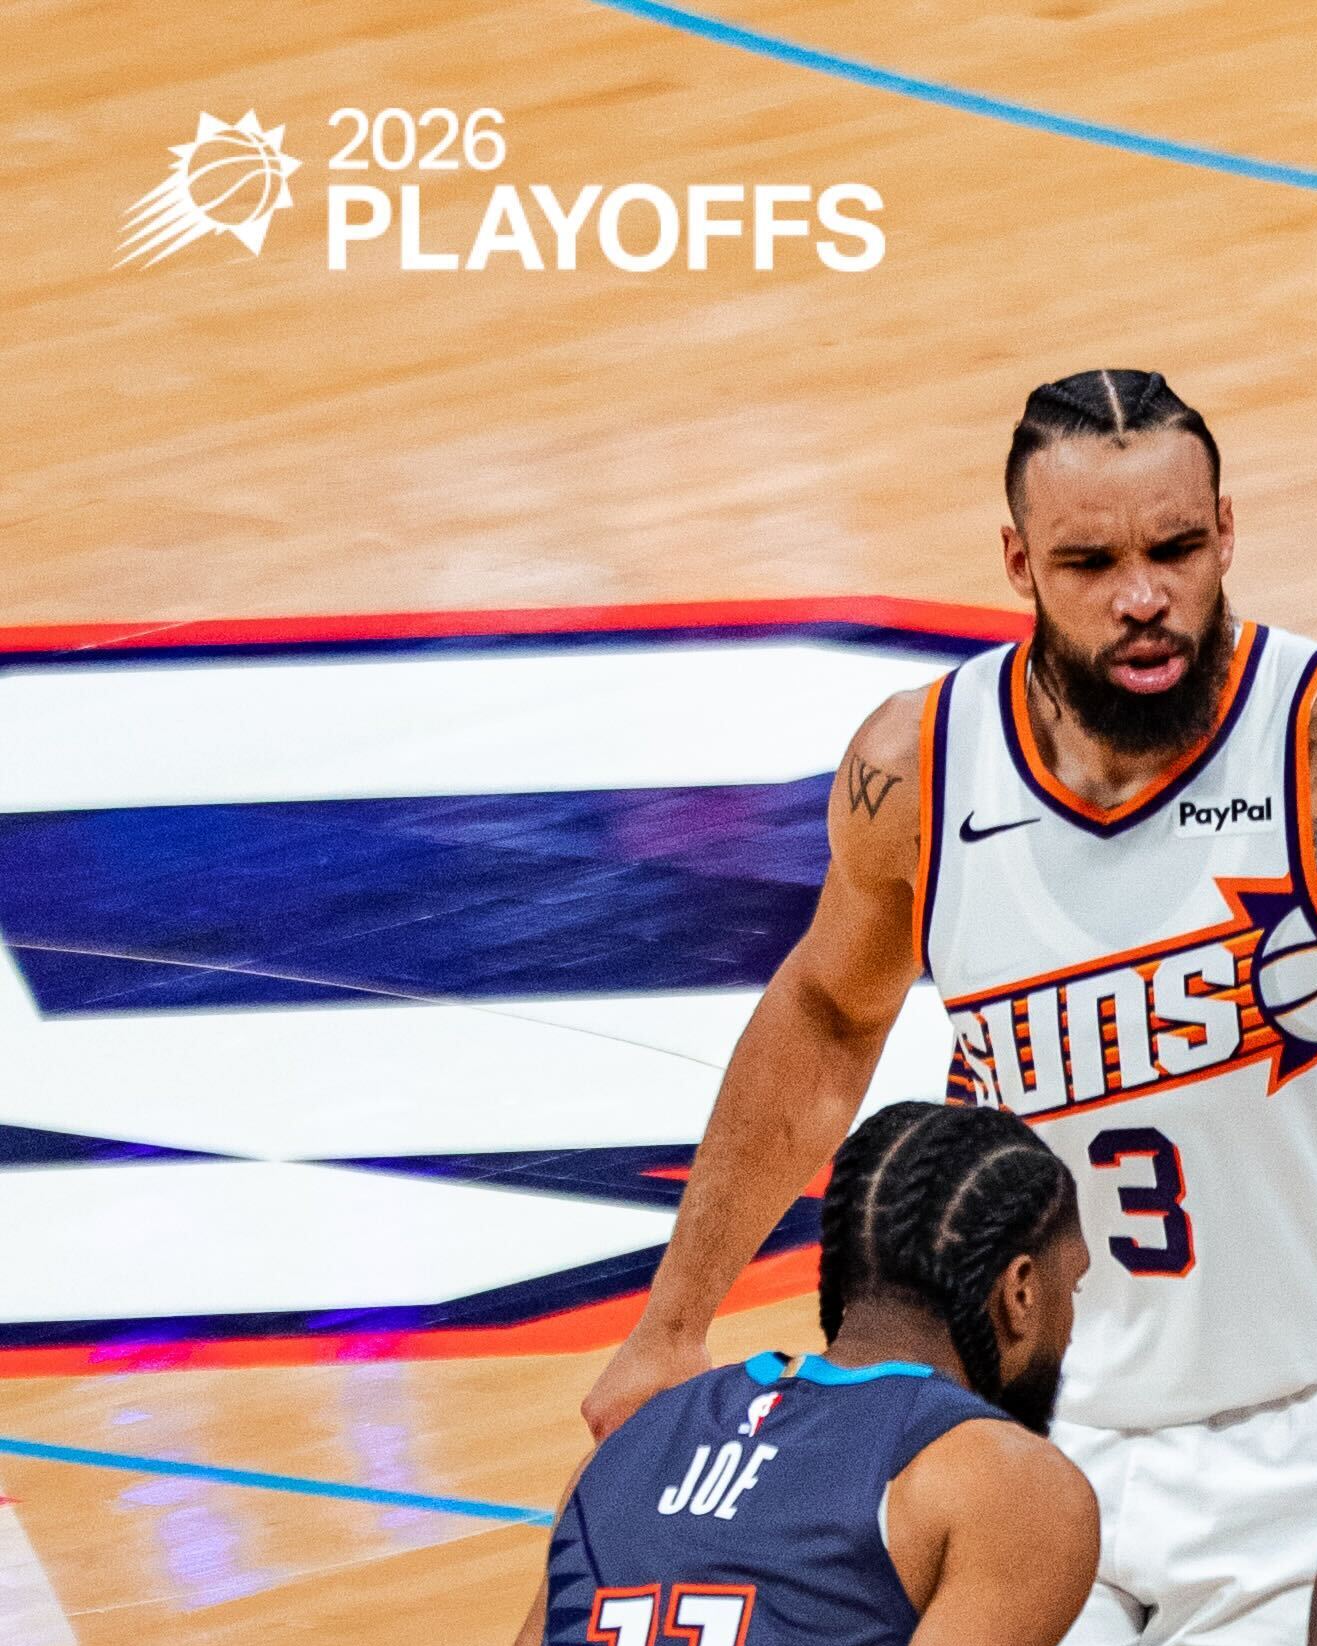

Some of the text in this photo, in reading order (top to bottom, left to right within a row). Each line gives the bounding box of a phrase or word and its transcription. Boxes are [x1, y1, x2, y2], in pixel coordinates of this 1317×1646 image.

[1179, 796, 1272, 832] PayPal
[950, 942, 1241, 1116] SUNS
[1087, 1126, 1196, 1279] 3
[657, 1440, 779, 1520] JOE
